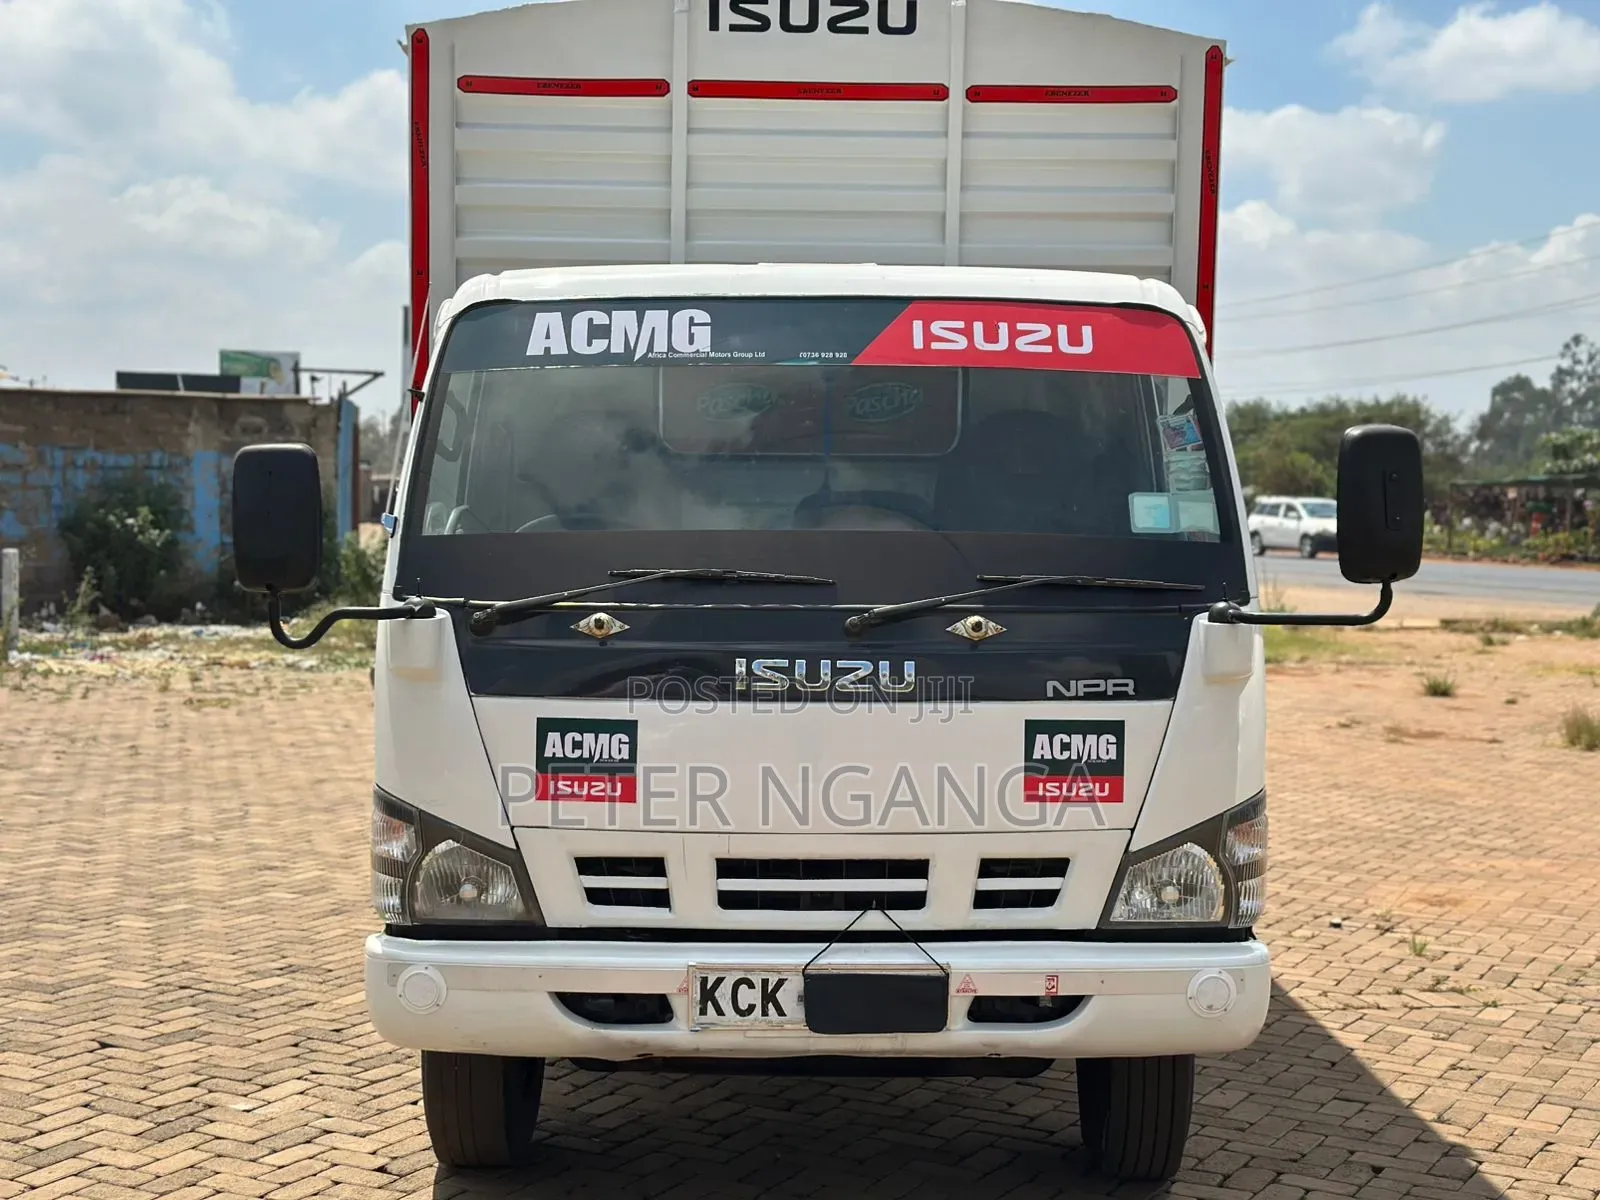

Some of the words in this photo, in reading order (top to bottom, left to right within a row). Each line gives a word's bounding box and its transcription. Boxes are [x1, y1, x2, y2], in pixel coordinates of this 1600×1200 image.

[709, 0, 917, 35] ISUZU
[526, 308, 711, 362] ACMG
[912, 320, 1093, 355] ISUZU
[732, 351, 753, 359] Group
[735, 658, 916, 693] ISUZU
[1046, 679, 1135, 697] NPR
[543, 732, 630, 763] ACMG
[1032, 733, 1117, 764] ACMG
[549, 781, 622, 796] ISUZU
[1038, 782, 1110, 797] ISUZU
[699, 976, 788, 1017] KCK
